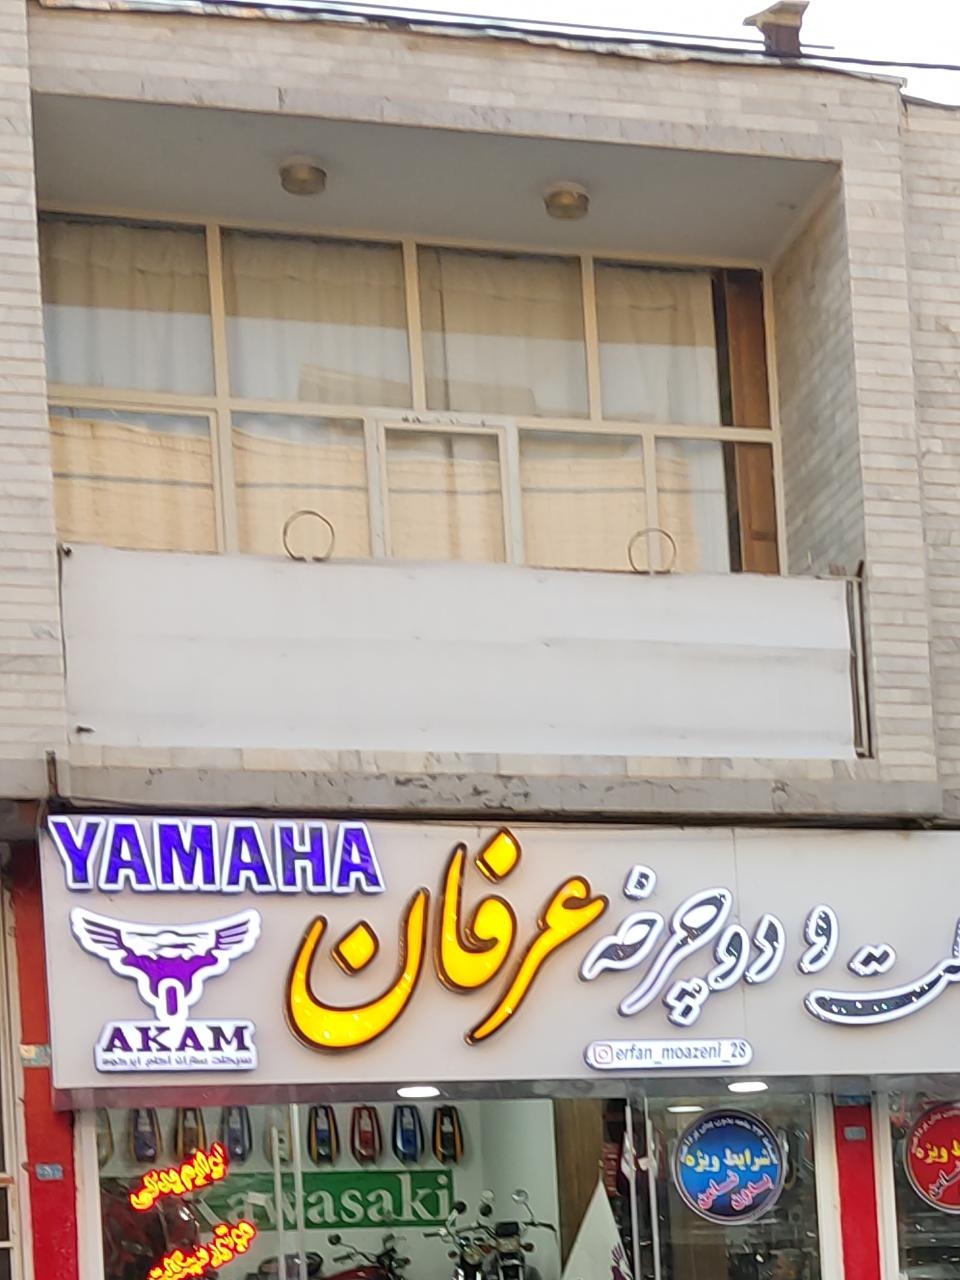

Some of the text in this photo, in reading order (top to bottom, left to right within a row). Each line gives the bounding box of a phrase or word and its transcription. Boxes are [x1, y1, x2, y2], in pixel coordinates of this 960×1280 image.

[48, 815, 386, 893] YAMAHA
[286, 826, 610, 1056] عرفان
[579, 864, 786, 1027] دوچرخه
[102, 1025, 252, 1053] AKAM
[685, 1147, 771, 1173] شرایط ویژه
[915, 1142, 949, 1164] ویژه
